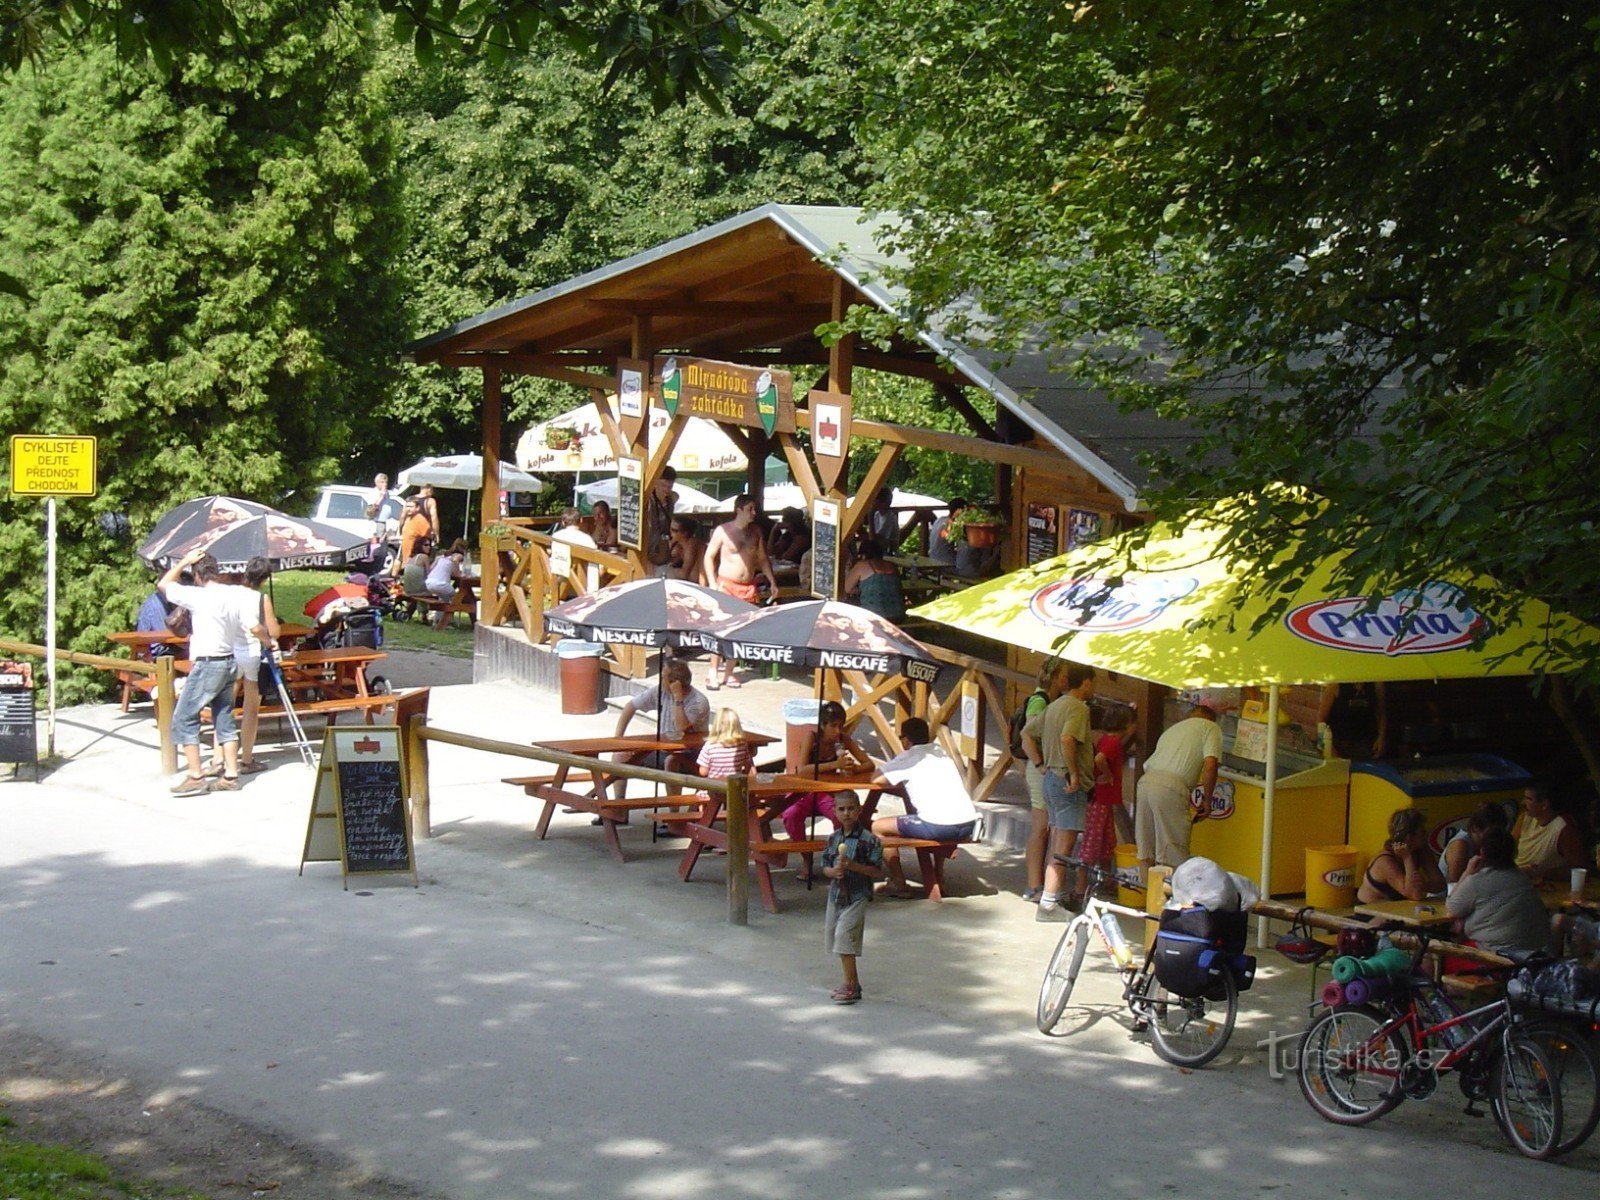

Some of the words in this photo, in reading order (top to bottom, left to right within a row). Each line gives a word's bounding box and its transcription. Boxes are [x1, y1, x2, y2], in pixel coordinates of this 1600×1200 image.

[23, 440, 79, 453] CYKLISTÉ
[37, 455, 70, 466] DEJTE
[527, 454, 555, 469] kofola
[593, 455, 616, 468] kofo
[709, 454, 738, 468] kofola
[26, 466, 80, 478] PŘEDNOST
[28, 479, 79, 490] CHODCŮM
[592, 626, 656, 646] NESCAFÉ
[733, 641, 793, 664] NESCAFÉ
[820, 651, 889, 672] NESCAFÉ
